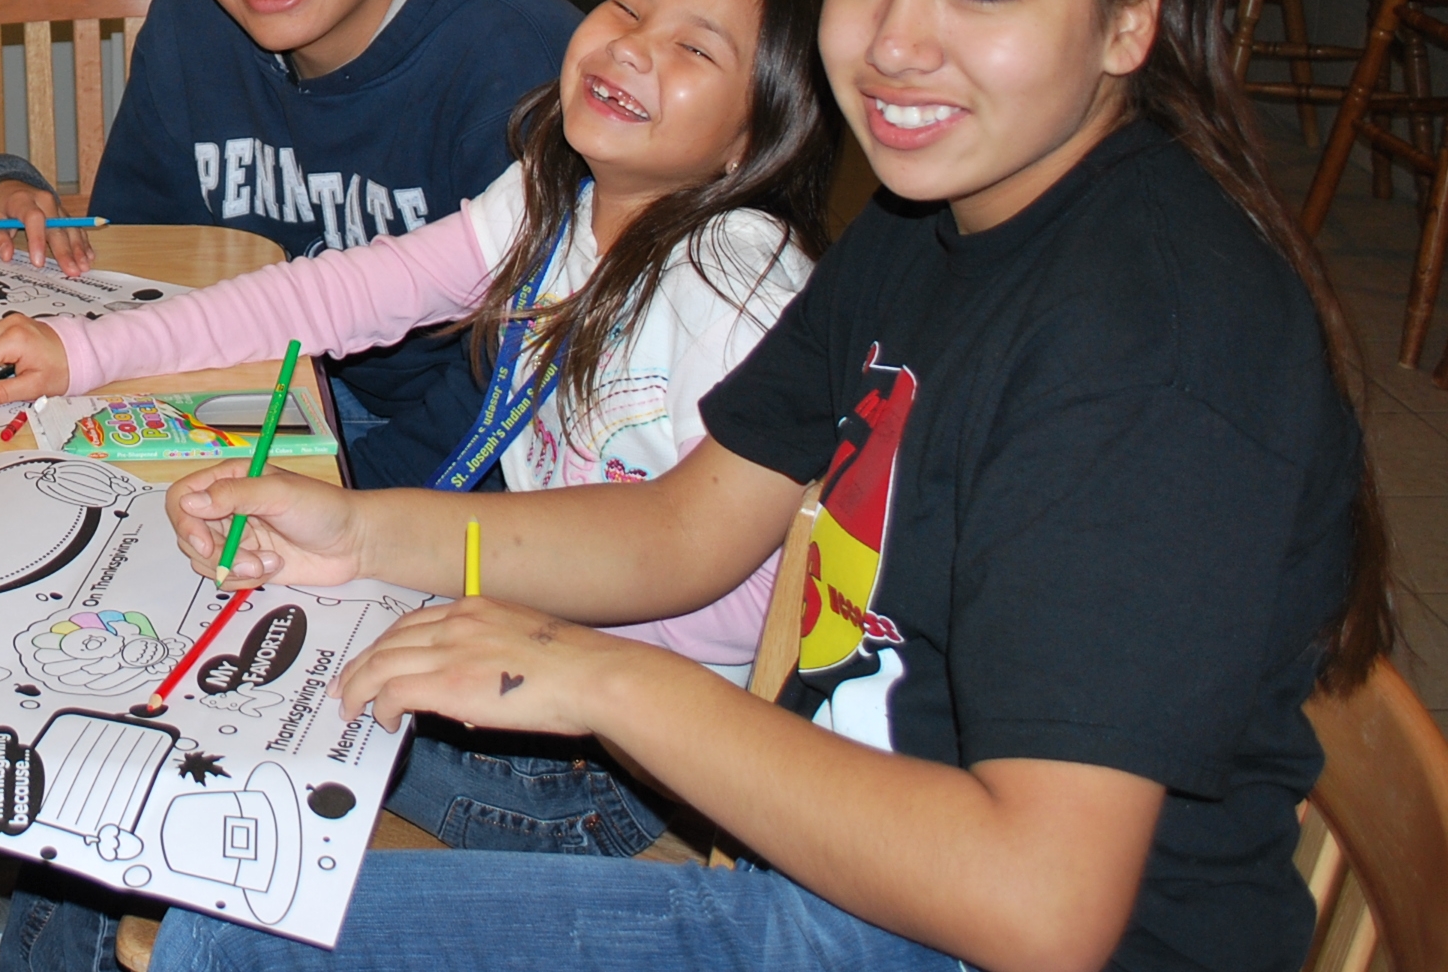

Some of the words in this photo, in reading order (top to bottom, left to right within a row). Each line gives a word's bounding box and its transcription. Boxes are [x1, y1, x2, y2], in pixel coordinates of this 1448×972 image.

[163, 448, 195, 458] Colored
[451, 472, 470, 489] St.
[468, 429, 506, 479] Joseph's
[502, 397, 531, 431] Indian
[90, 537, 140, 591] Thanksgiving
[82, 593, 103, 607] On
[265, 676, 326, 752] Thanksgiving
[305, 649, 336, 676] food
